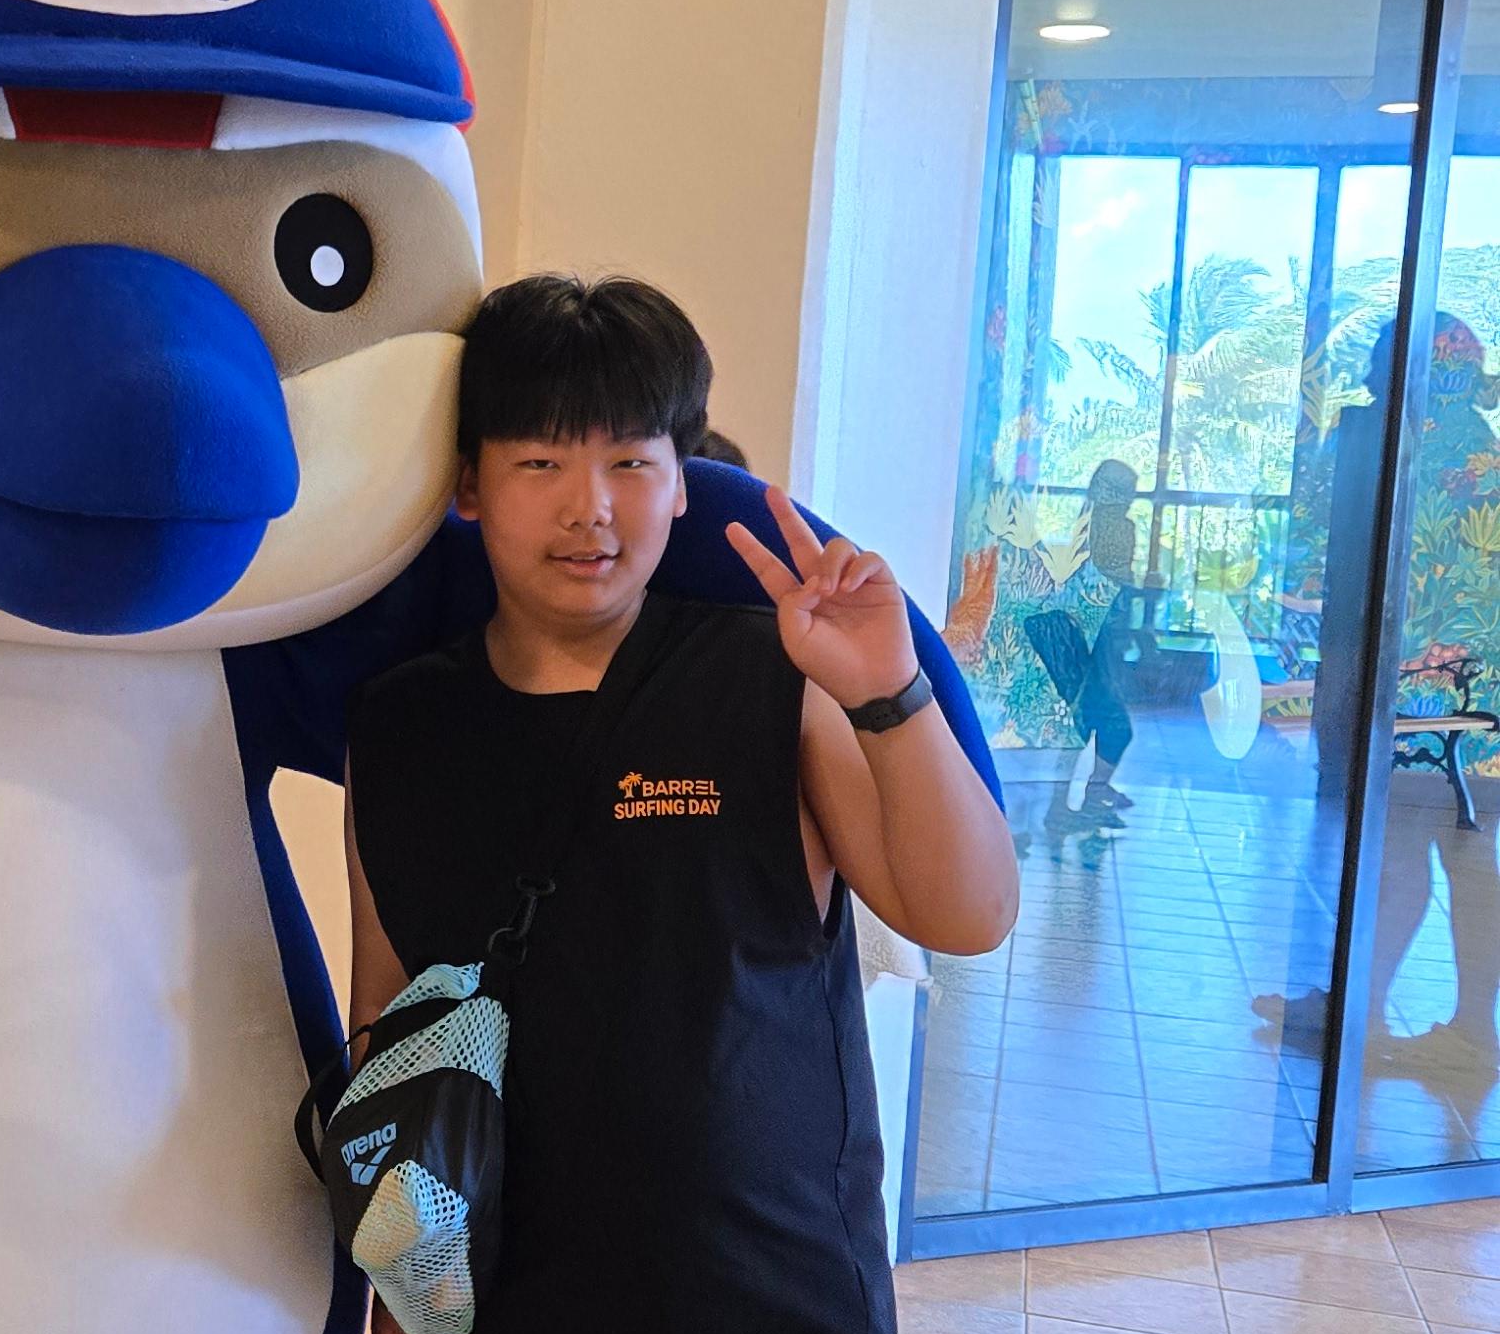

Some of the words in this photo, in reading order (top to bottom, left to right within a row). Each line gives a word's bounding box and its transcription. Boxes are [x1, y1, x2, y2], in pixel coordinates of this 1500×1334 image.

[642, 780, 721, 797] BARREL
[614, 799, 685, 820] SURFING
[688, 799, 721, 815] DAY
[341, 1123, 397, 1167] arena
